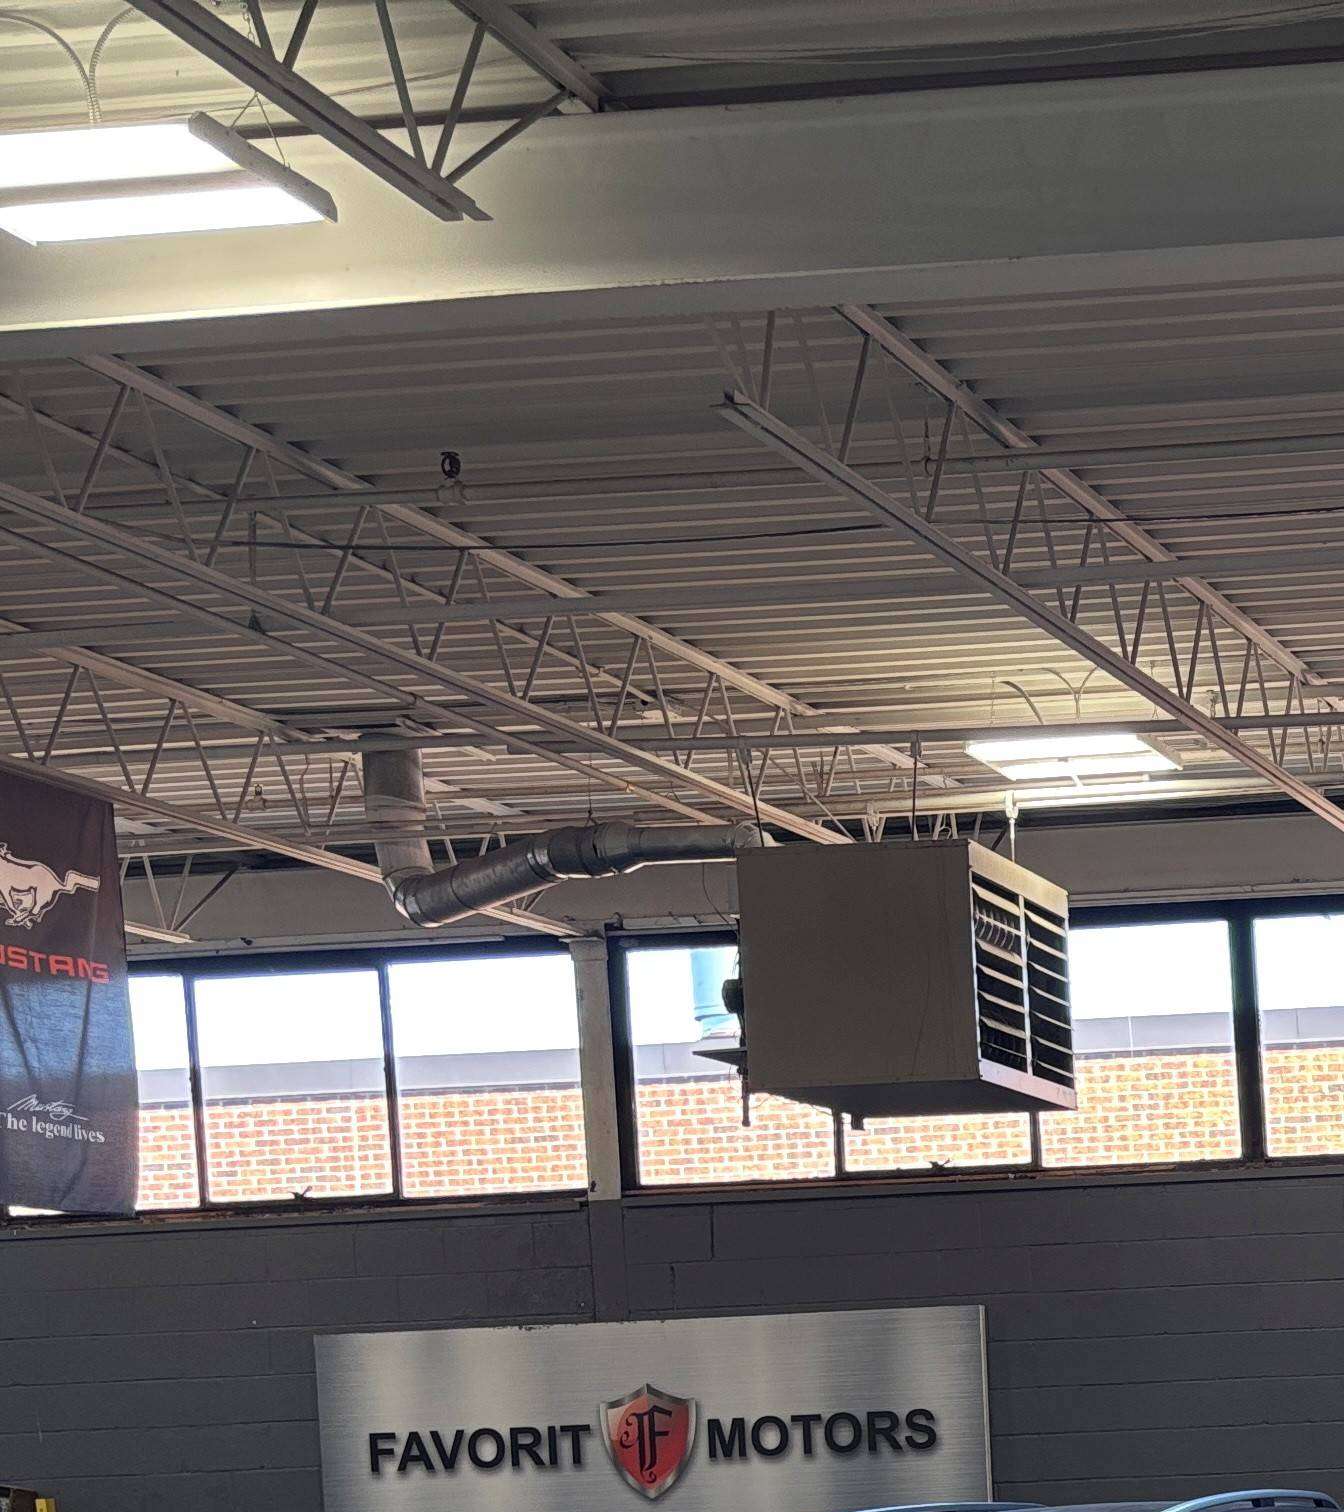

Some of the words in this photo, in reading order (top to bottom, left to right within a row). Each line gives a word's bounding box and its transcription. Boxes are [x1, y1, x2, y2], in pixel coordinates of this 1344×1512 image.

[32, 1116, 73, 1139] legend
[74, 1124, 106, 1143] lives
[368, 1424, 591, 1472] FAVORIT
[706, 1408, 937, 1458] MOTORS
